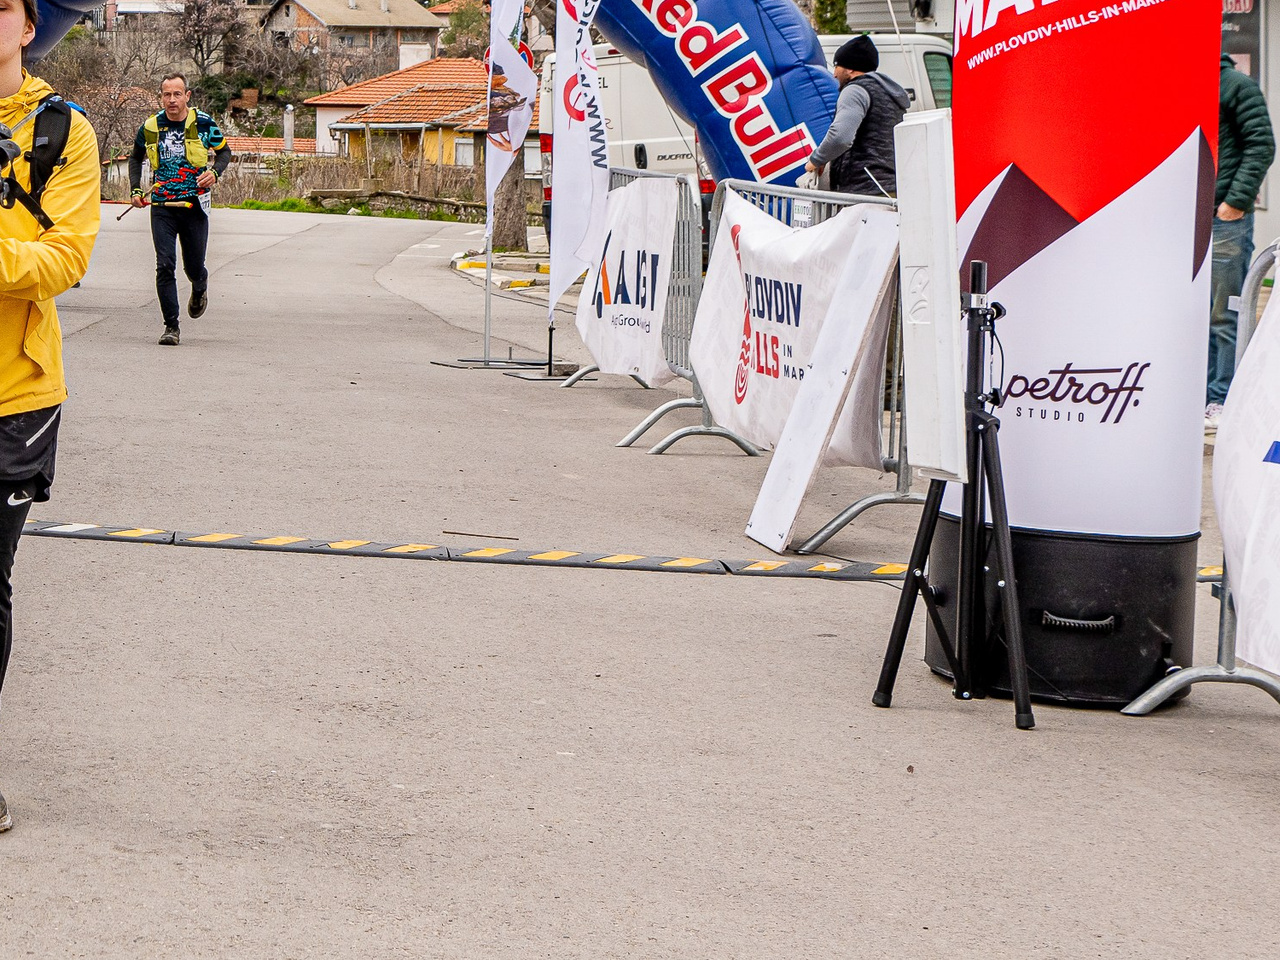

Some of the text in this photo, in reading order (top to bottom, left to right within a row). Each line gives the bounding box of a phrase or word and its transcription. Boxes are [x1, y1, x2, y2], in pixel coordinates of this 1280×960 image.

[704, 54, 816, 181] Bull
[657, 153, 692, 161] DUCATO
[783, 343, 793, 358] IN
[997, 362, 1151, 425] petroff.
[1016, 406, 1085, 423] STUDIO
